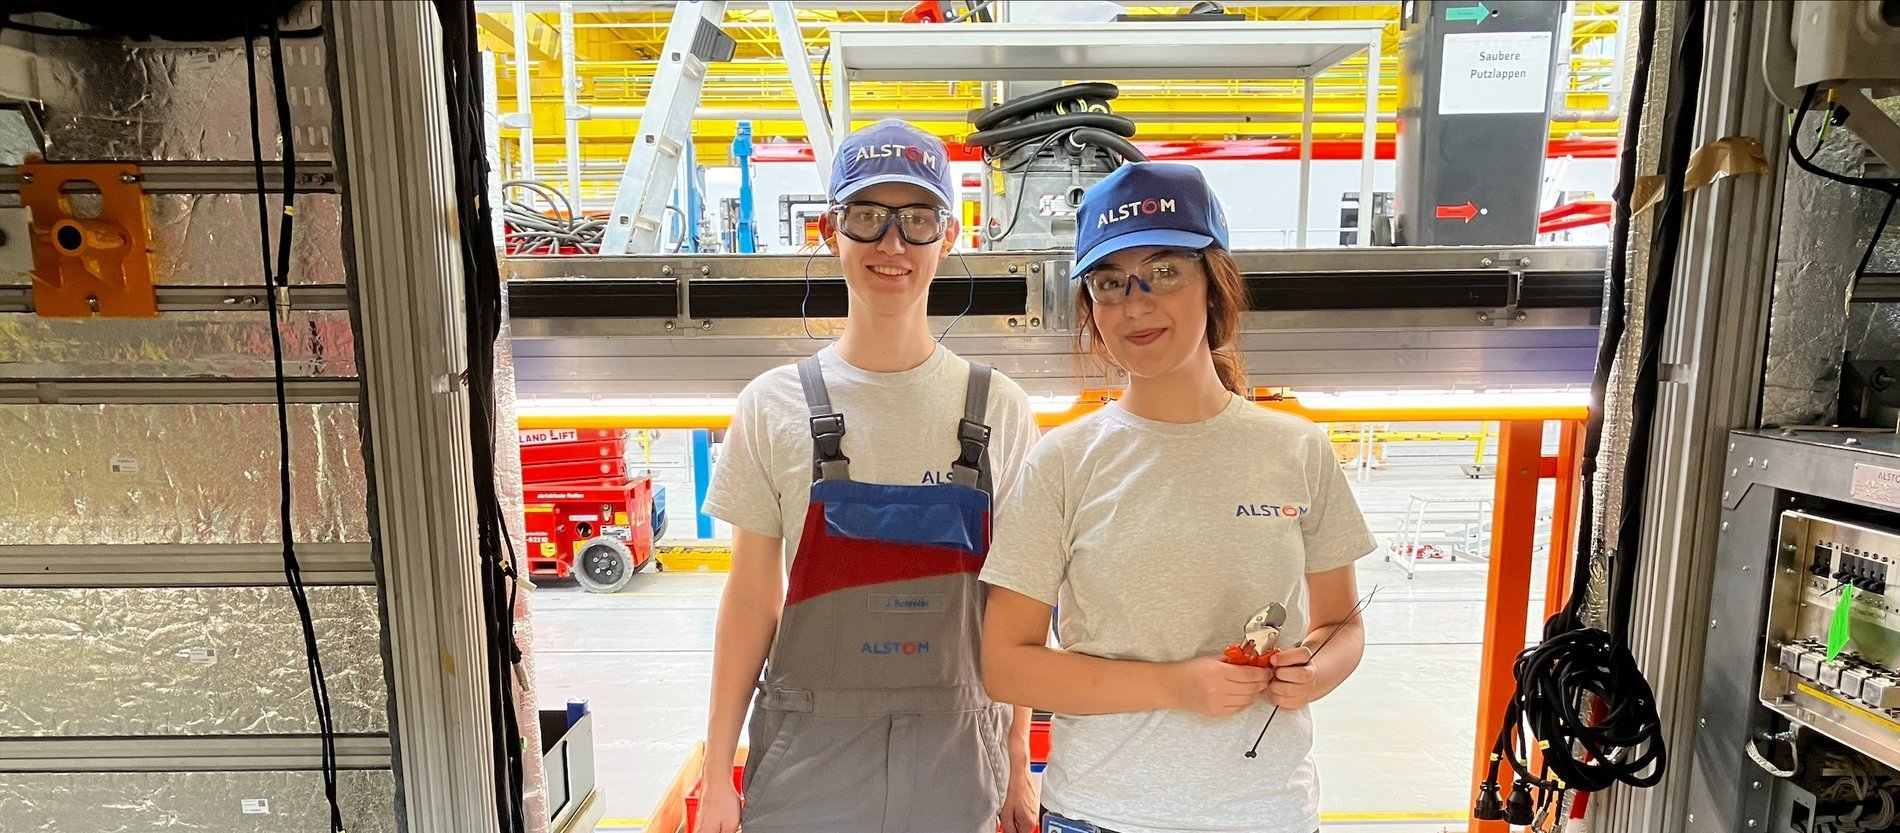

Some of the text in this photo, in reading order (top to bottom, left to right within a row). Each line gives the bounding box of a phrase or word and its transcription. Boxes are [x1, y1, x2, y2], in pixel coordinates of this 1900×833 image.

[1479, 50, 1521, 61] Saubere
[1470, 68, 1527, 81] Putzlappen
[855, 144, 936, 170] ALSTOM
[1097, 198, 1176, 229] ALSTOM
[549, 429, 575, 441] LIFT
[861, 640, 930, 656] ALSTOM
